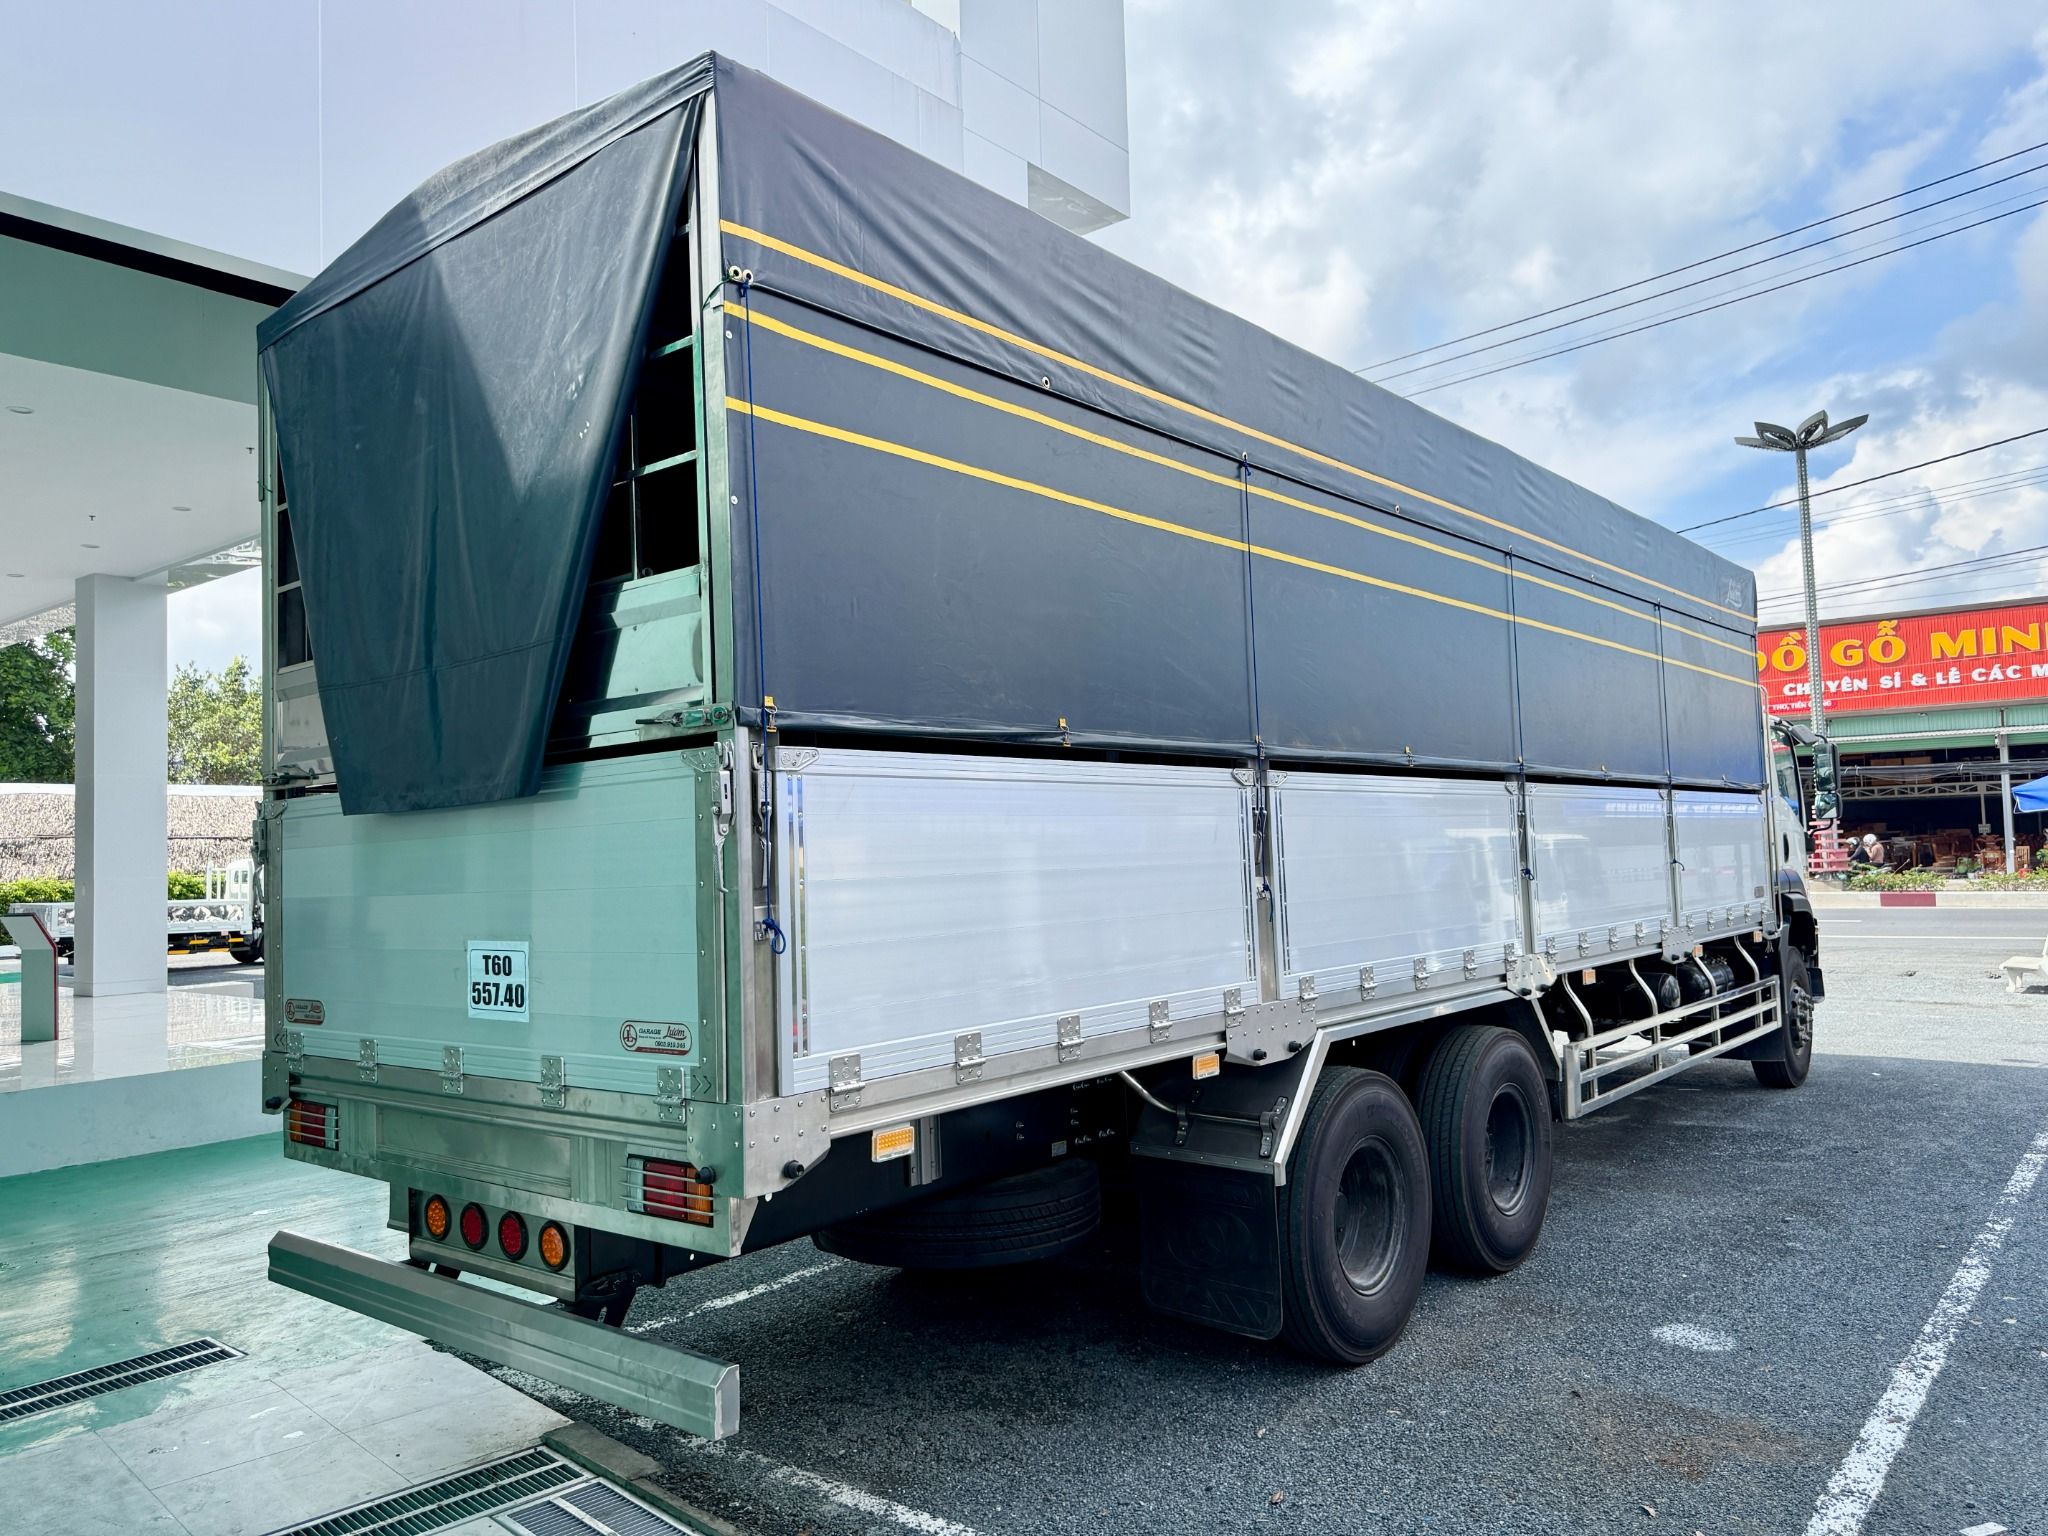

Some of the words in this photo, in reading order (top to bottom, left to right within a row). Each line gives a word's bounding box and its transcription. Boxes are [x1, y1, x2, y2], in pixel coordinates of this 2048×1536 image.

[1830, 619, 1906, 667] GỖ
[1930, 622, 2048, 660] MIN
[1782, 675, 1868, 696] CHYÊN
[1910, 672, 1928, 687] &
[1971, 663, 2022, 682] CÁC
[482, 954, 512, 977] T60
[471, 981, 525, 1009] 557.40
